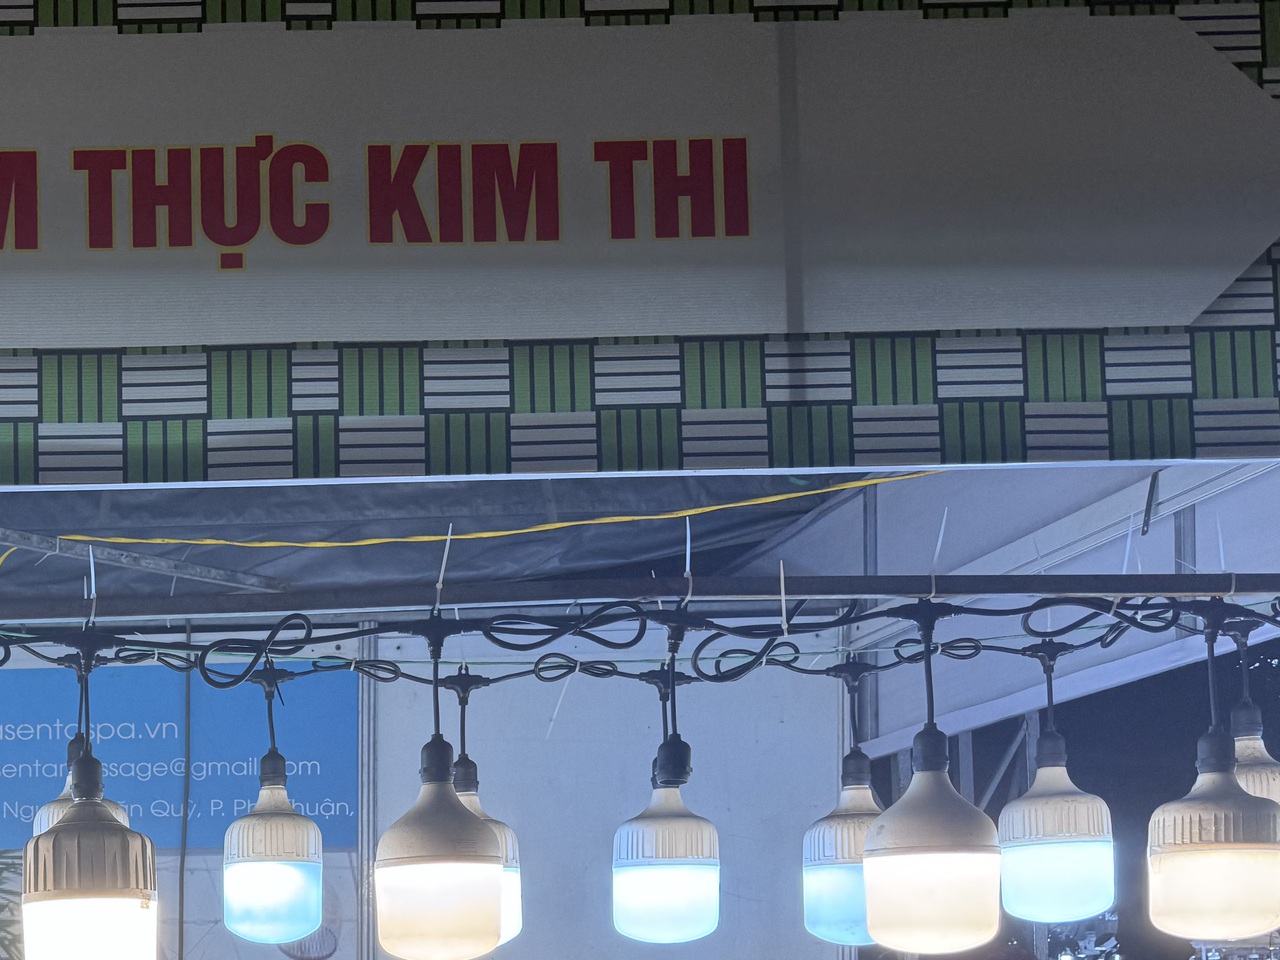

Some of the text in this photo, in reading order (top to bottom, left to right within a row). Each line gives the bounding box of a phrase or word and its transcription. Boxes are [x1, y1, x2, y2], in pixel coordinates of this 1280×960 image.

[71, 133, 331, 271] THỰC
[367, 141, 562, 244] KIM
[592, 136, 752, 240] THI
[211, 799, 225, 816] P.
[234, 799, 258, 816] Ph
[289, 798, 354, 819] huận,
